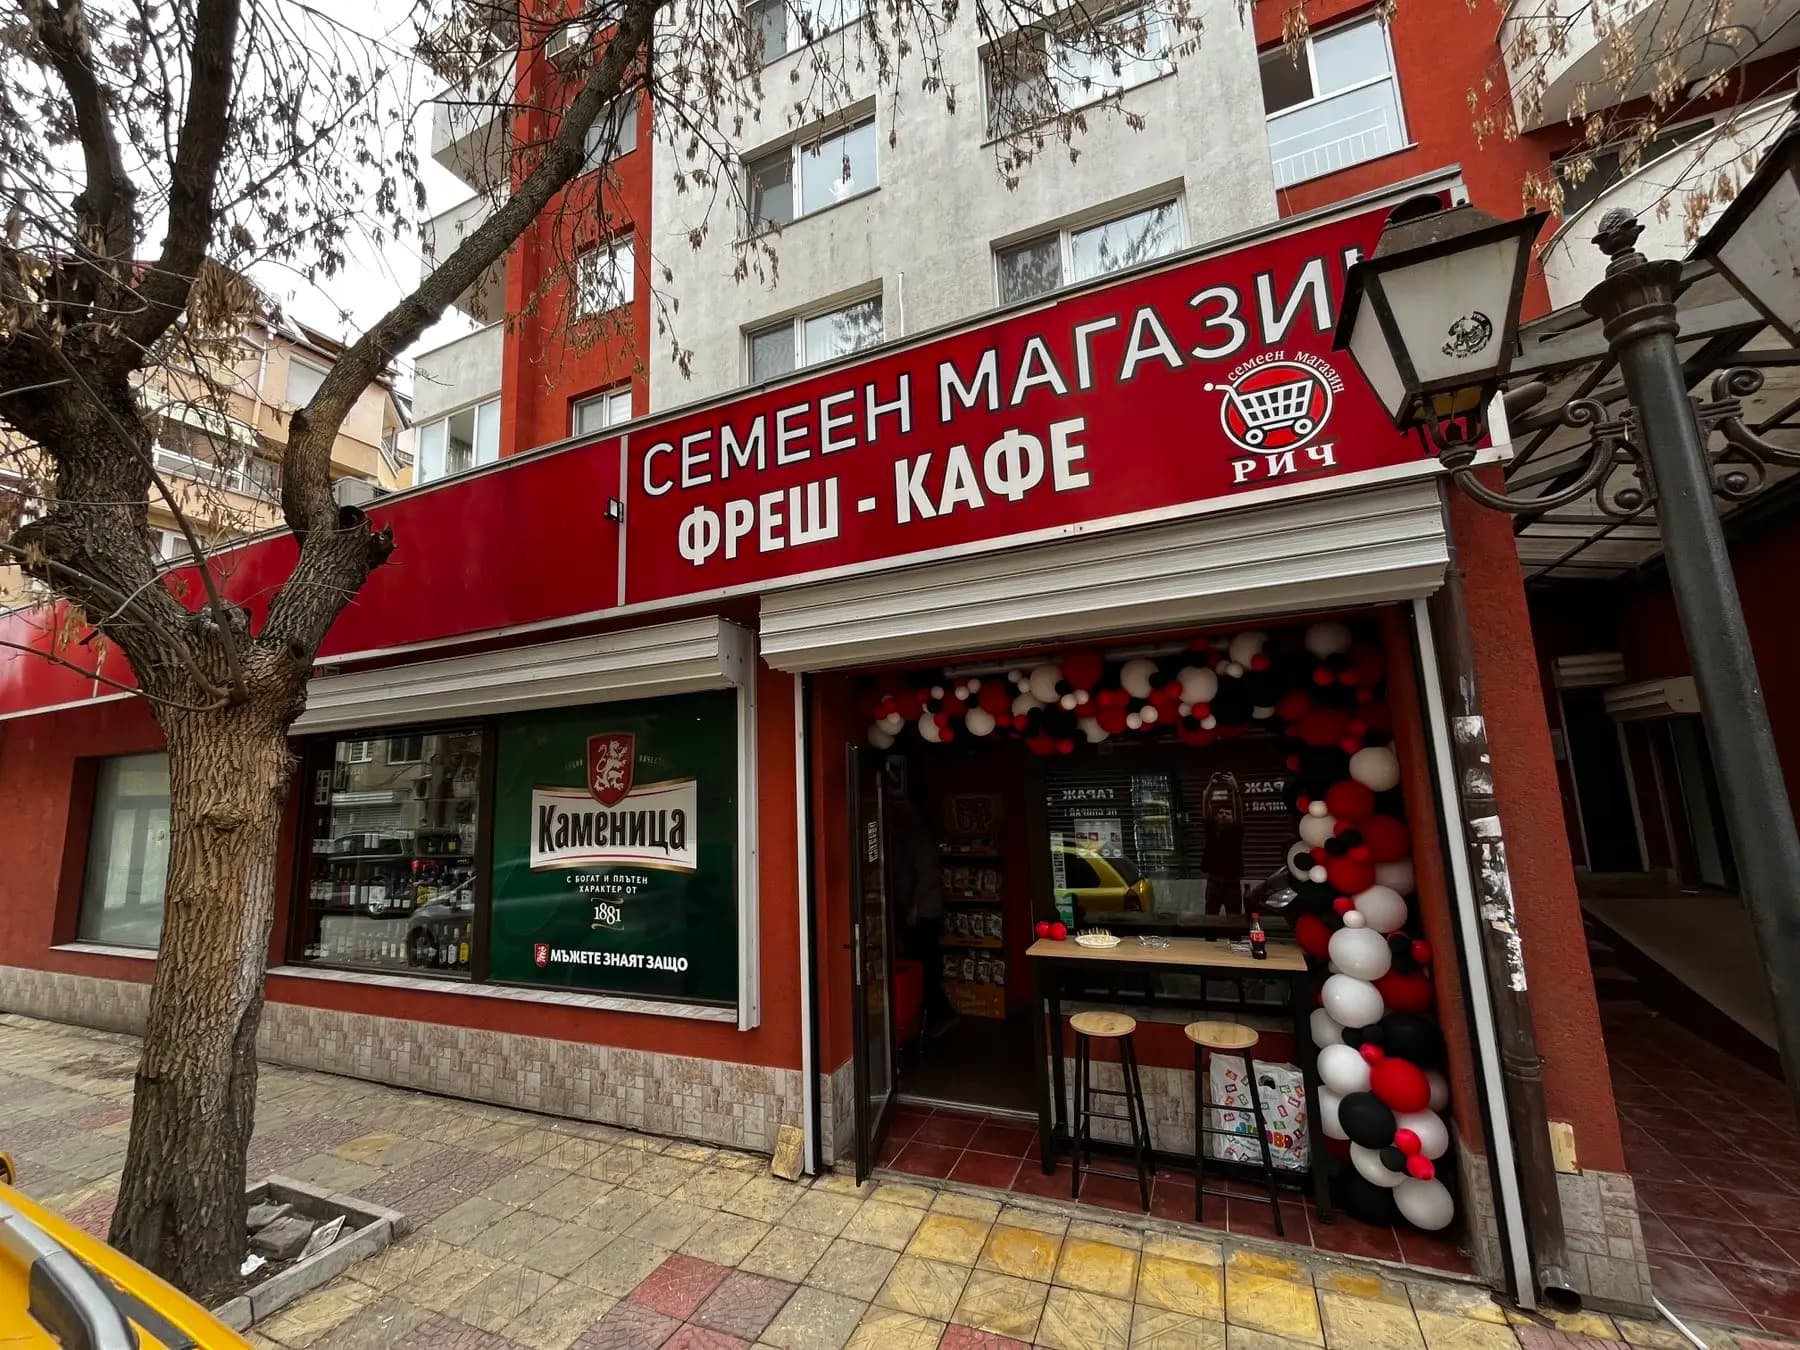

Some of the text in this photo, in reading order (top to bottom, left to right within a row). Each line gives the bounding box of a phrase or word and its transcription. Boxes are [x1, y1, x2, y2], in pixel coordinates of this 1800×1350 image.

[642, 248, 1362, 496] СЕМЕЕН МАГАЗИ
[1227, 350, 1285, 382] семеен
[1231, 443, 1337, 483] РИЧ
[678, 477, 839, 566] ФРЕШ
[895, 417, 1090, 525] КАФЕ
[538, 804, 689, 855] Каменица
[566, 875, 648, 885] С БОГАТ И ПЛЪТЕН
[579, 885, 638, 895] ХАРАКТЕР ОТ
[593, 902, 622, 925] 1881
[550, 948, 689, 973] МЪЖЕТЕ ЗНАЯТ ЗАЩО
